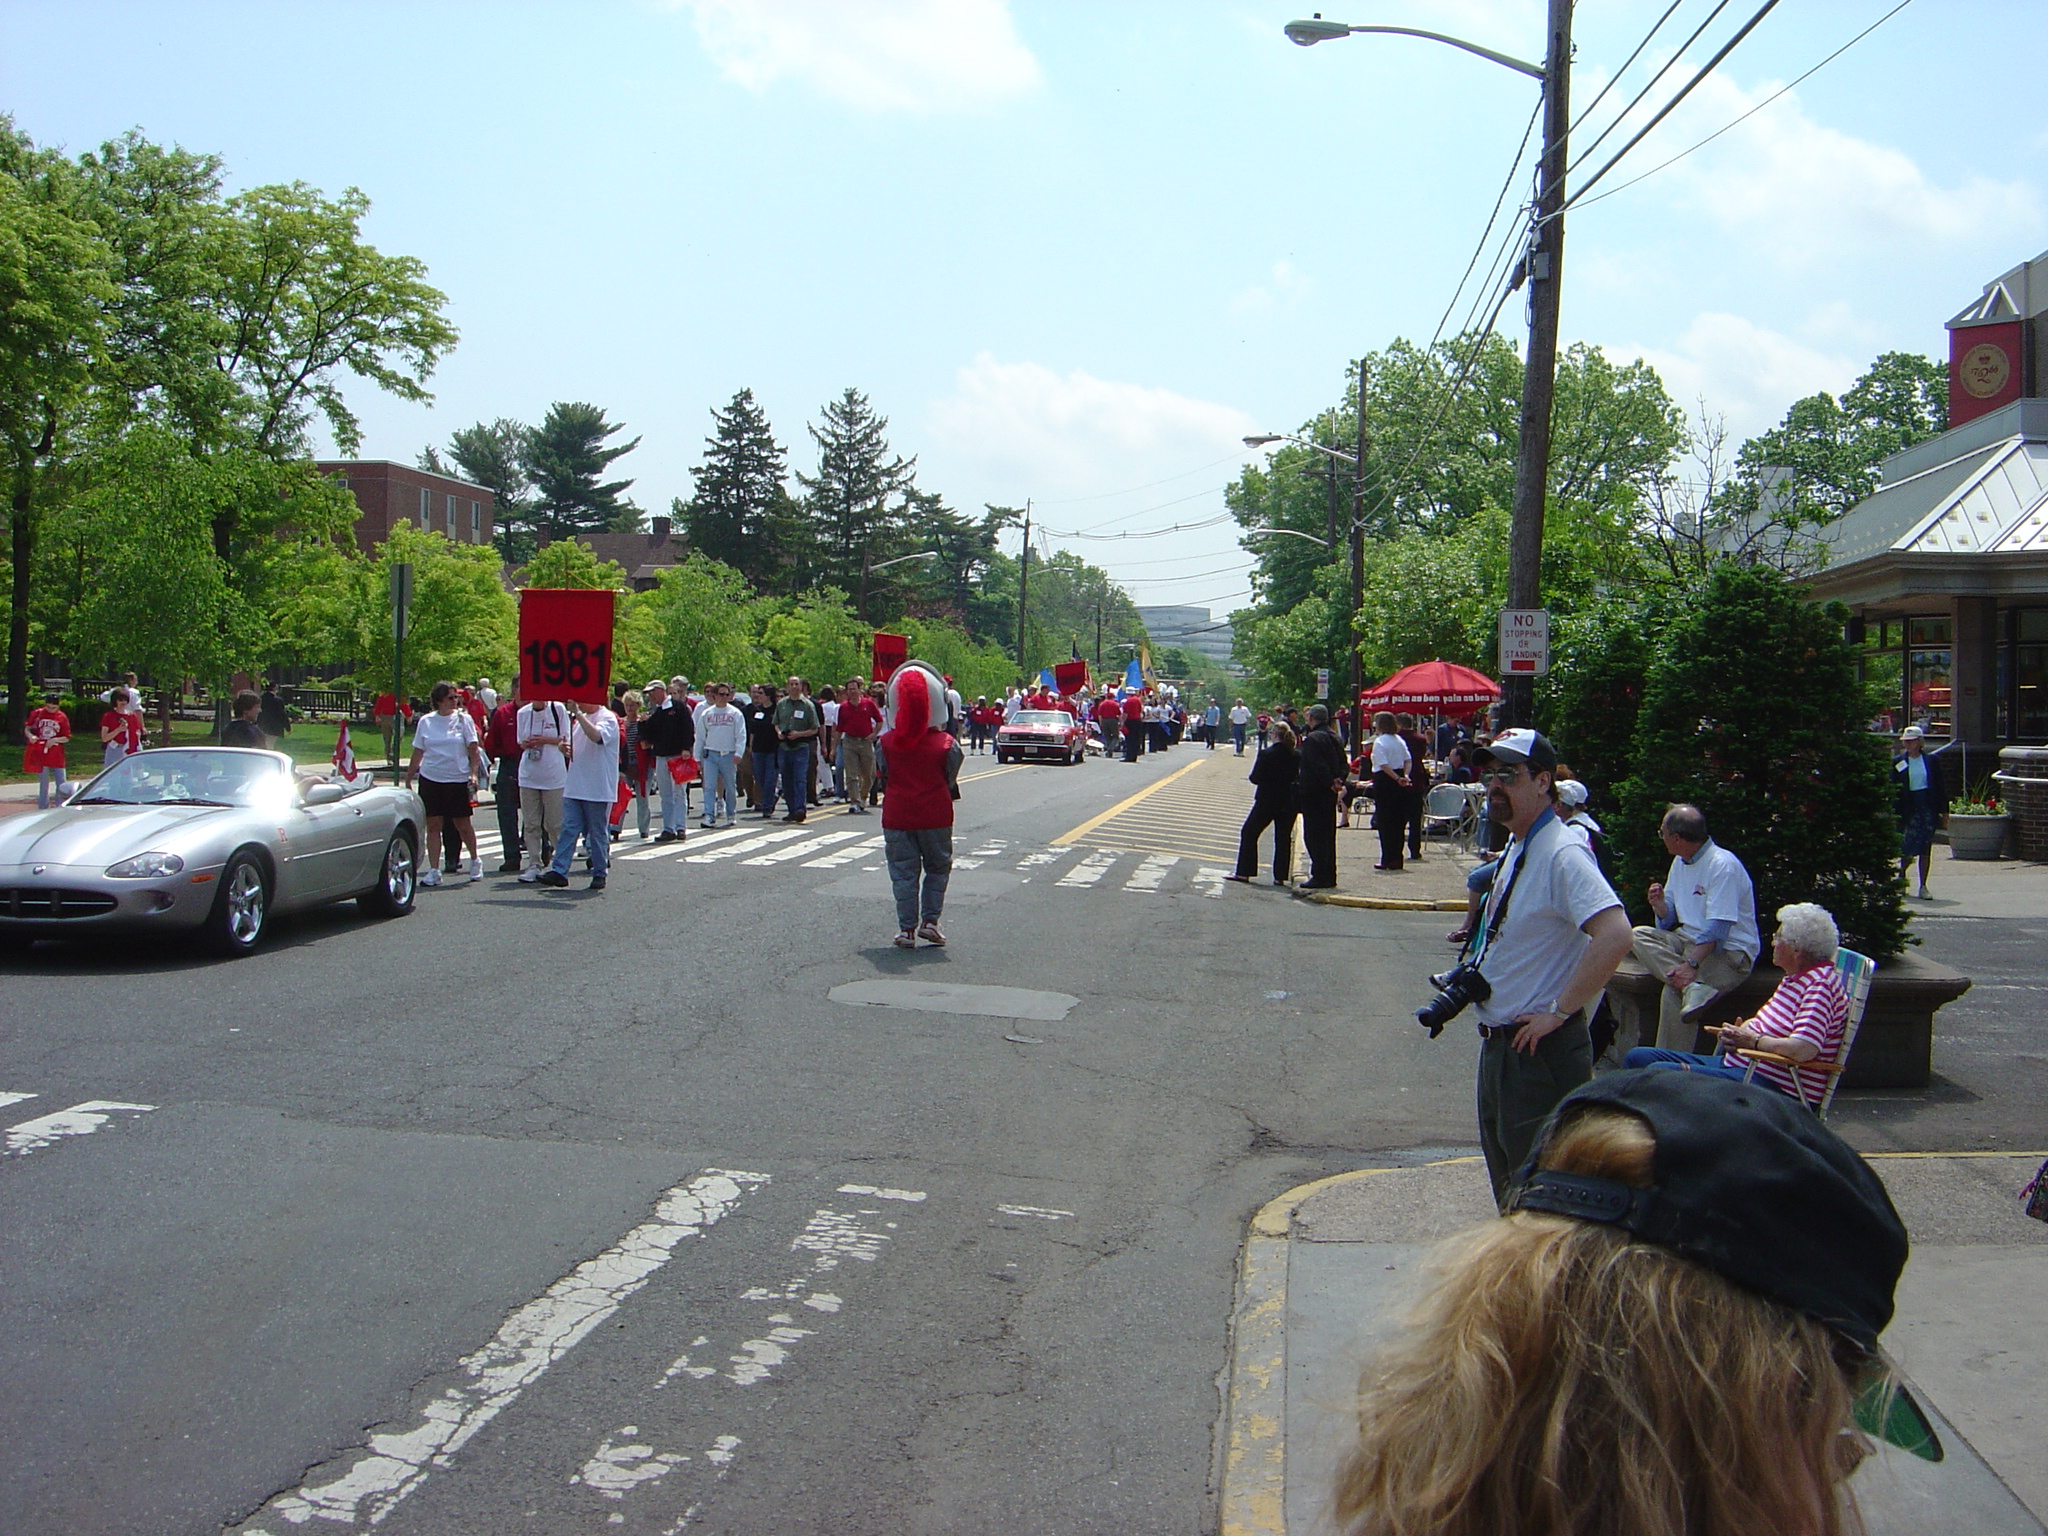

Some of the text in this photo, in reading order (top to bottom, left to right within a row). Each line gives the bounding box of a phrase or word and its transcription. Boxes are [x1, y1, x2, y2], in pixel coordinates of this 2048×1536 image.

[1514, 614, 1534, 626] NO
[1505, 630, 1543, 638] STOPPING
[1518, 640, 1529, 648] OR
[524, 640, 607, 688] 1981
